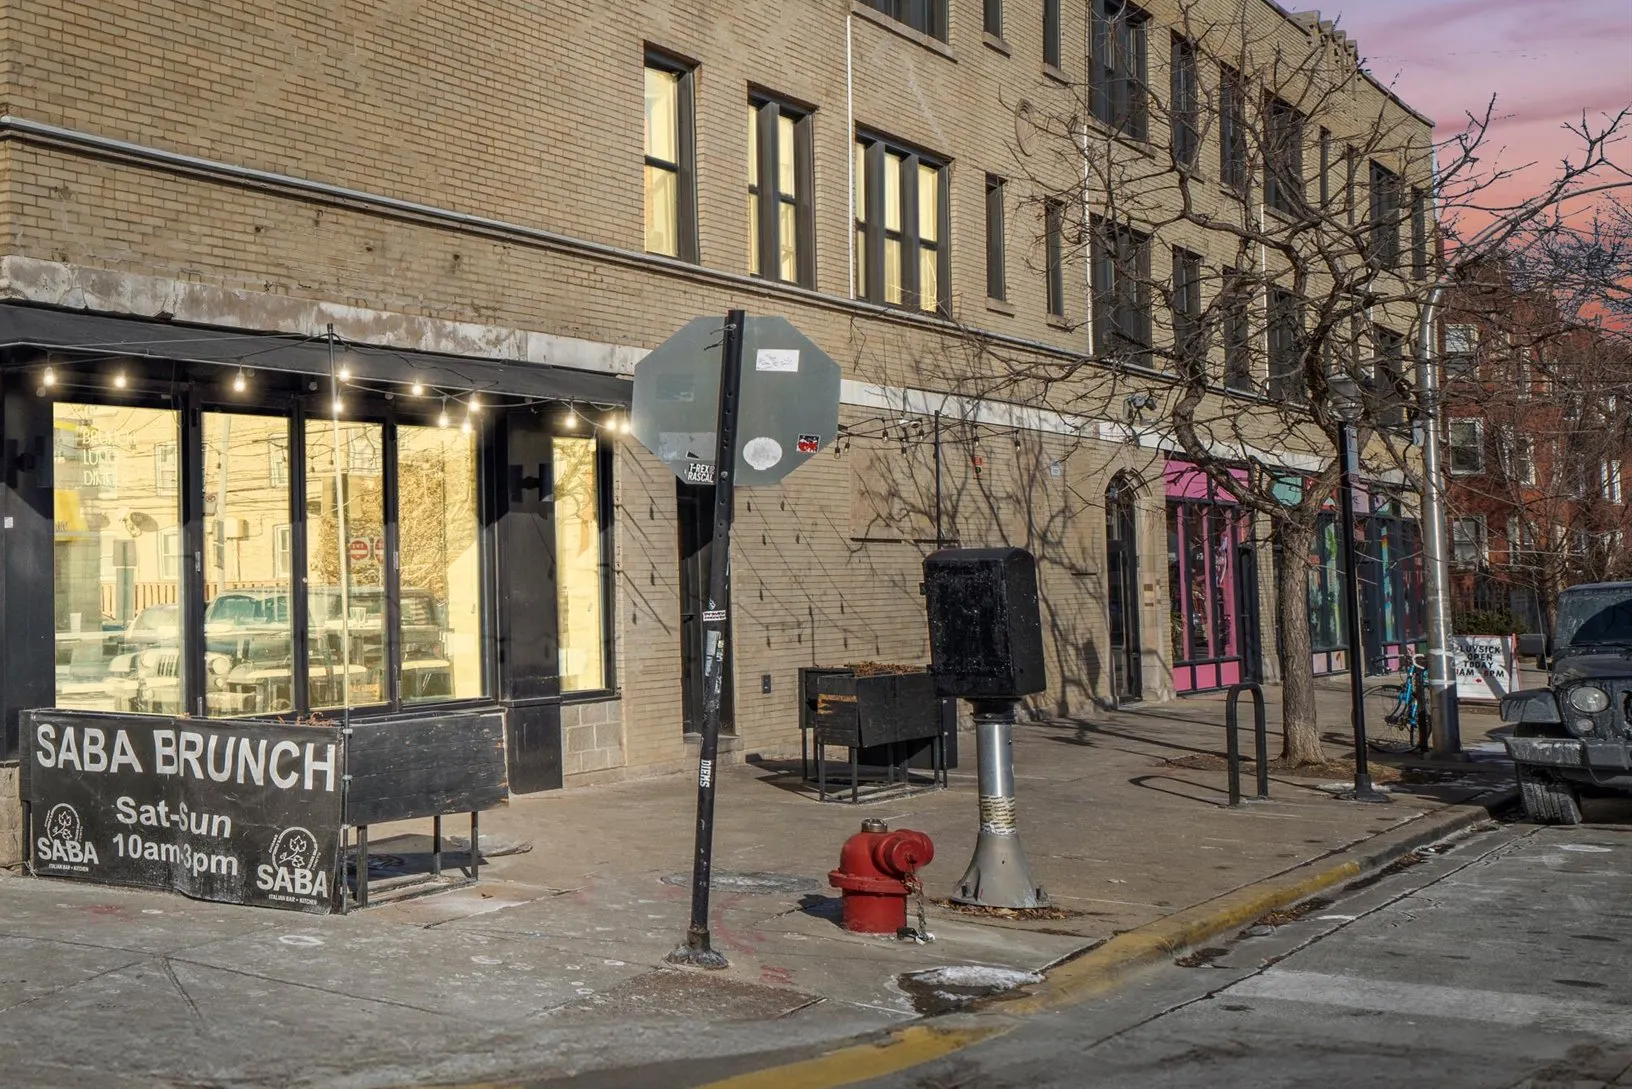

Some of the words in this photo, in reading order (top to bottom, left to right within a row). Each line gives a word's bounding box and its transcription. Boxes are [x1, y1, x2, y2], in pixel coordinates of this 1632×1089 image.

[688, 472, 714, 482] RASCAL
[1460, 645, 1500, 654] LUVSICK
[1467, 653, 1493, 661] OPEN
[1463, 661, 1493, 669] TODAY
[36, 723, 143, 773] SABA
[153, 729, 335, 792] BRUNCH
[116, 795, 232, 838] Sat-Sun
[37, 837, 99, 865] SABA
[256, 864, 328, 898] SABA
